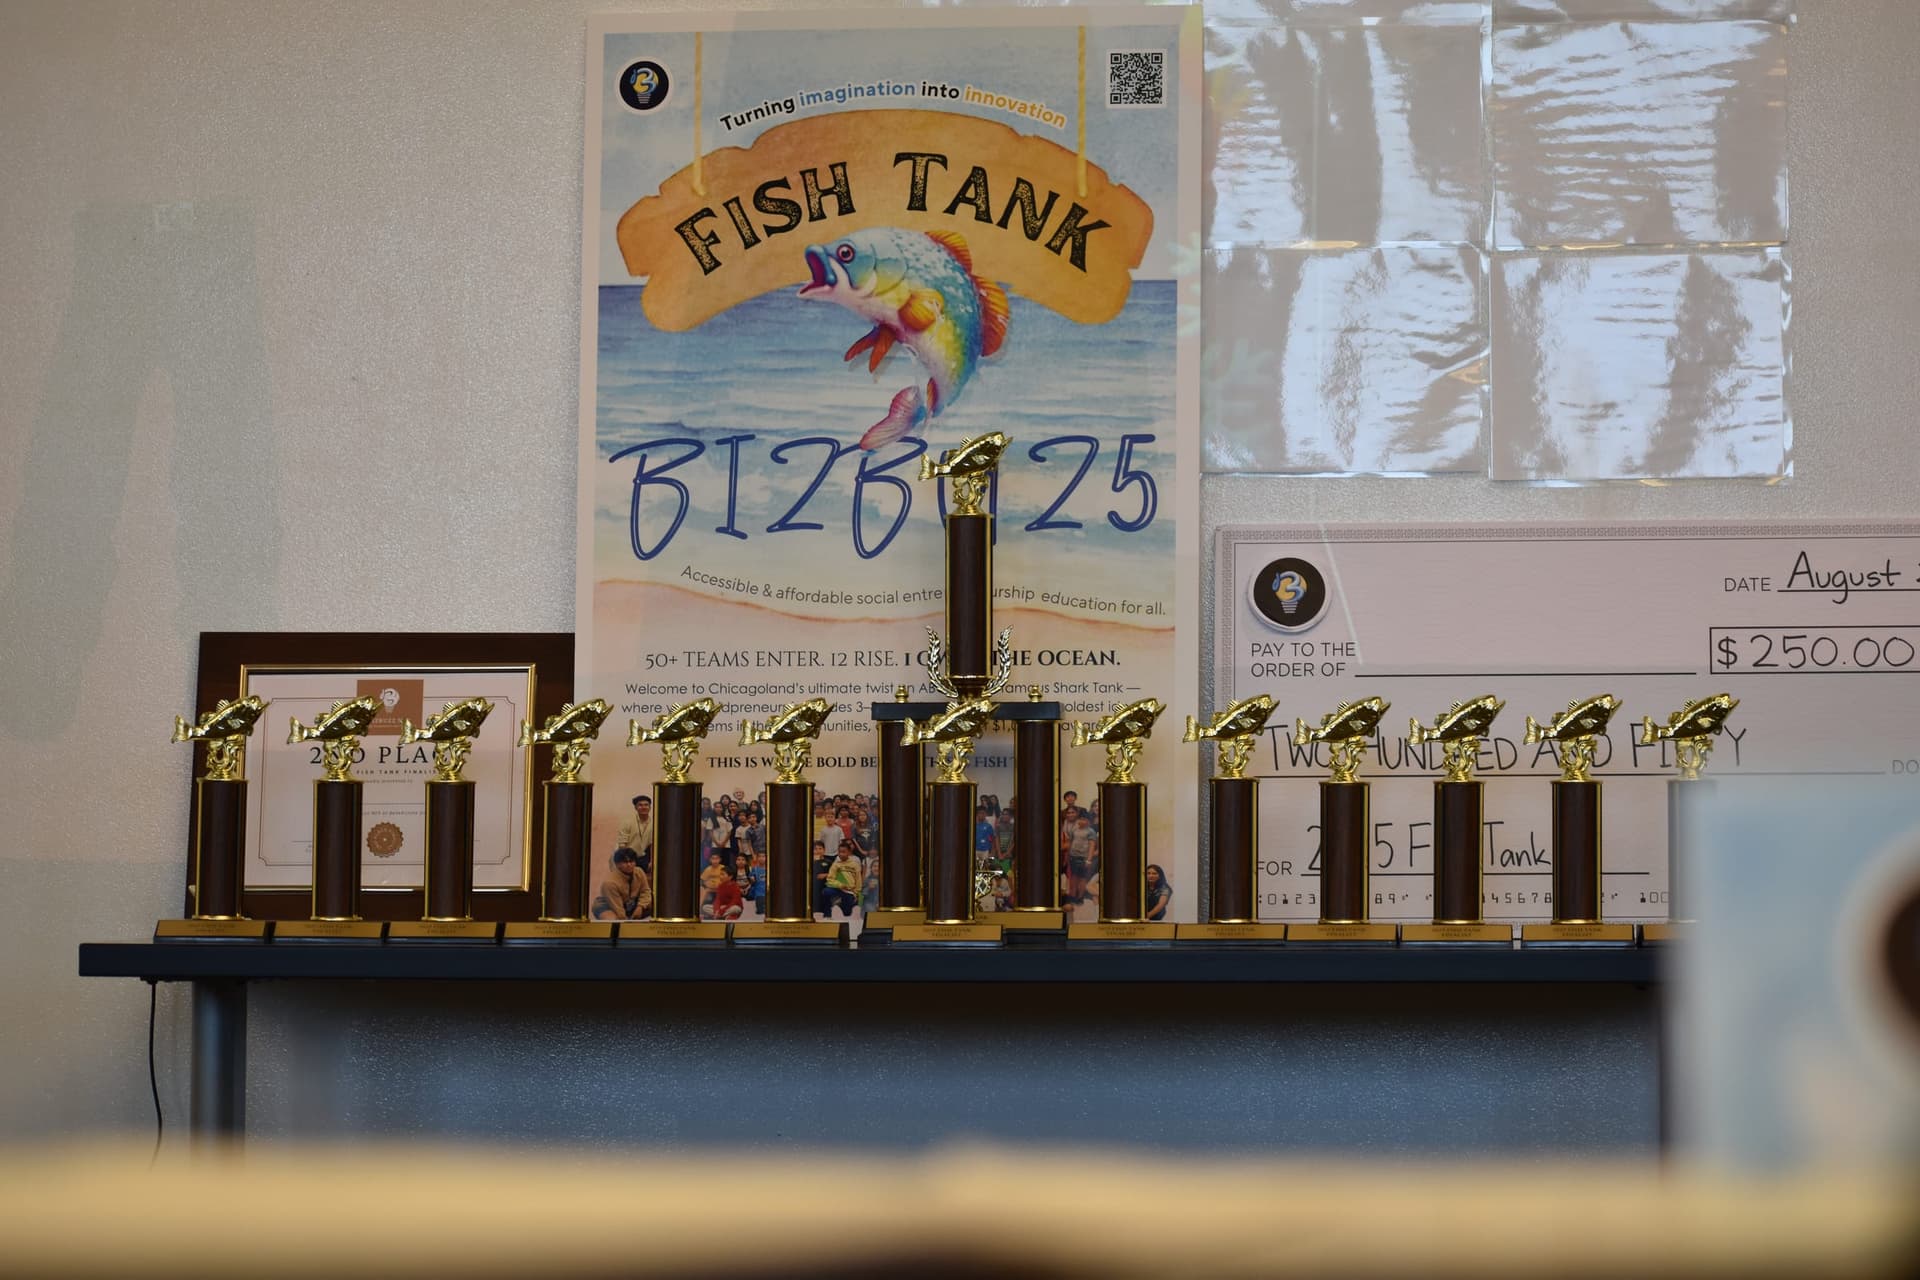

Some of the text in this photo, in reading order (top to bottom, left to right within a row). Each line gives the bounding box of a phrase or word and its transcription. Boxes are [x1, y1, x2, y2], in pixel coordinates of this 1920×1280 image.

[720, 81, 1065, 130] Turning imagination into innovation
[674, 152, 1112, 276] FISH TANK
[1025, 434, 1157, 532] 25
[680, 565, 759, 595] Accessible
[762, 583, 772, 597] &
[776, 586, 852, 604] affordable
[857, 590, 899, 604] social
[1041, 591, 1116, 612] education
[1121, 599, 1142, 614] for
[1146, 601, 1166, 615] all.
[1724, 577, 1771, 592] DATE
[1787, 550, 1901, 604] August
[645, 653, 678, 670] 50+
[683, 650, 749, 667] TEAMS
[755, 650, 824, 667] ENTER.
[854, 650, 898, 667] RISE.
[1038, 649, 1120, 666] OCEAN.
[1251, 642, 1356, 657] PAY TO THE
[1251, 662, 1346, 677] ORDER OF
[625, 683, 688, 695] Welcome
[692, 683, 704, 695] to
[708, 682, 804, 697] Chicagoland's
[808, 682, 861, 694] ultimate
[866, 682, 894, 694] twist
[1053, 681, 1089, 694] Shark
[1093, 682, 1124, 694] Tank
[621, 702, 662, 713] where
[1062, 700, 1104, 712] oldest
[379, 746, 448, 764] PLA
[708, 756, 741, 768] THIS
[745, 756, 757, 768] IS
[817, 756, 856, 768] BOLD
[1531, 736, 1612, 768] AD
[1630, 723, 1746, 768] FIY
[1257, 861, 1292, 876] FOR
[1483, 821, 1551, 867] Tank
